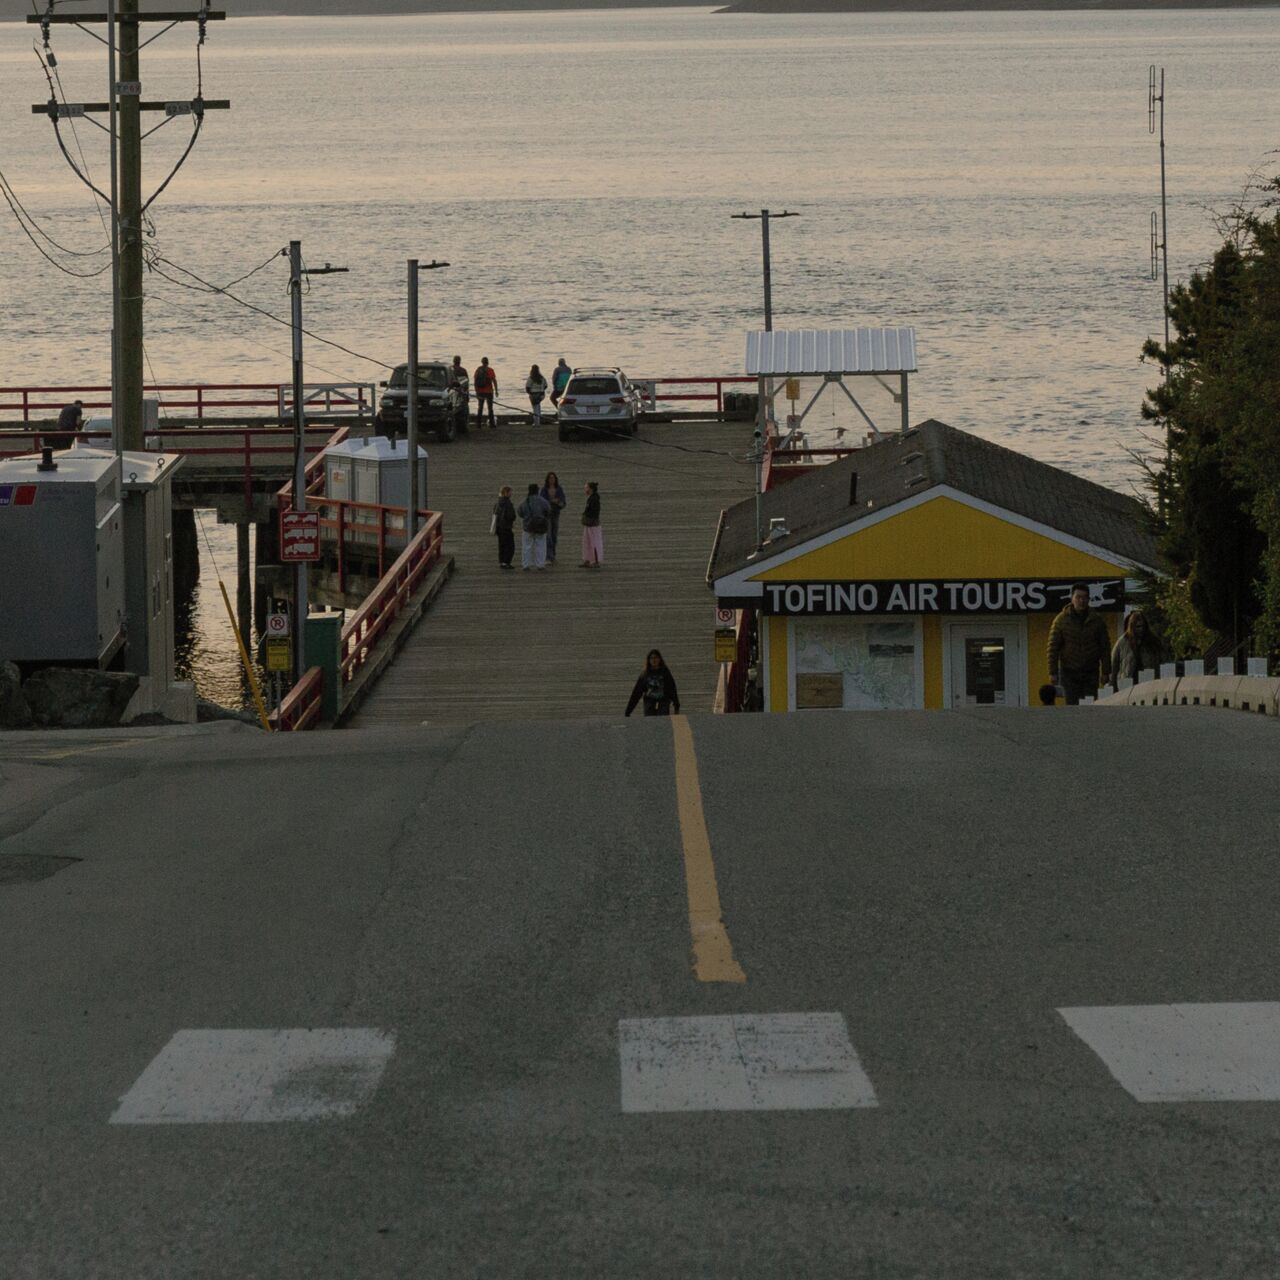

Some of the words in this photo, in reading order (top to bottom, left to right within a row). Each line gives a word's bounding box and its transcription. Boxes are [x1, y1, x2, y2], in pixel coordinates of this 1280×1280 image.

[766, 583, 877, 612] TOFINO
[885, 583, 939, 611] AIR
[943, 582, 1047, 610] TOURS
